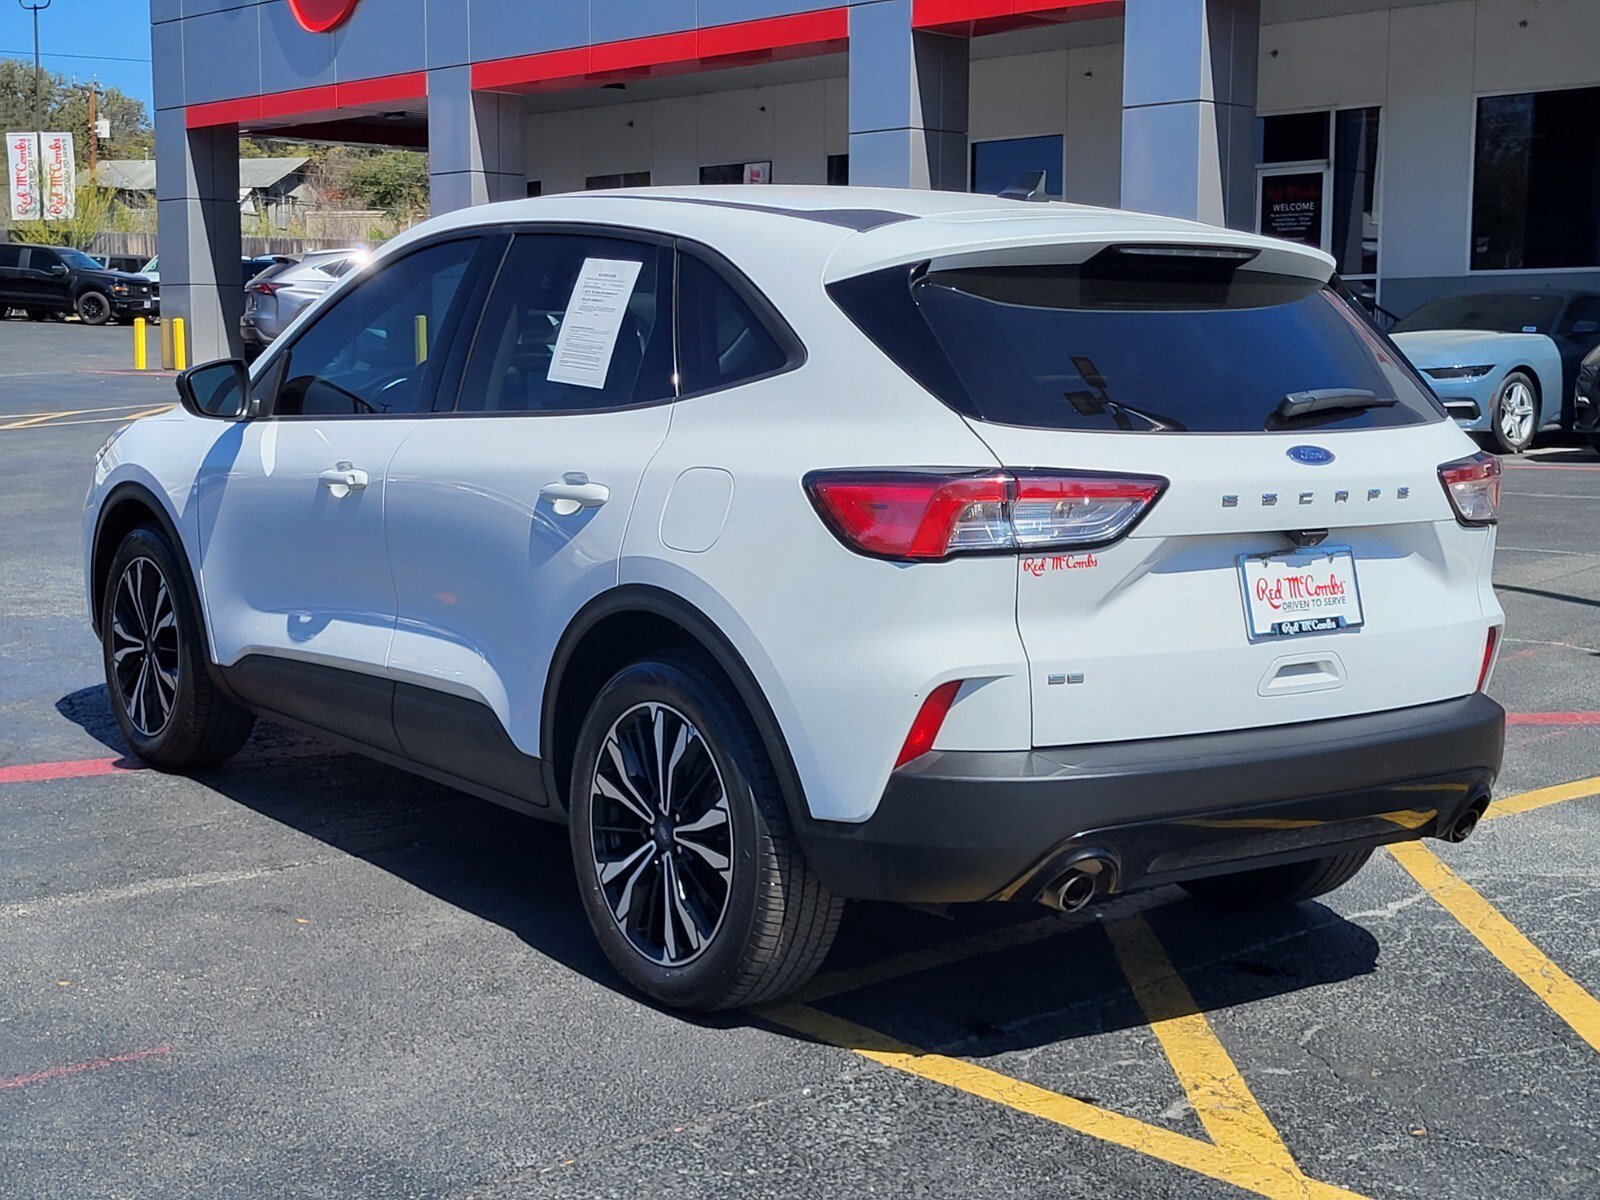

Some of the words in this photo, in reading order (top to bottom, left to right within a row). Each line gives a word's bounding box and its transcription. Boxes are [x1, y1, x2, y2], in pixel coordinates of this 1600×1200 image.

[14, 138, 28, 189] McCombs
[49, 138, 63, 188] McCombs
[17, 192, 33, 215] Red
[1272, 202, 1315, 212] WELCOME
[1221, 486, 1410, 508] ESCAPE
[1023, 557, 1047, 577] Red
[1049, 553, 1098, 571] McCombs
[1256, 577, 1284, 610] Red
[1283, 573, 1345, 599] McCombs
[1282, 600, 1310, 611] DRIVEN
[1312, 599, 1322, 608] TO
[1324, 596, 1346, 607] SERVE
[1281, 621, 1300, 635] Red
[1299, 618, 1337, 631] McCombs
